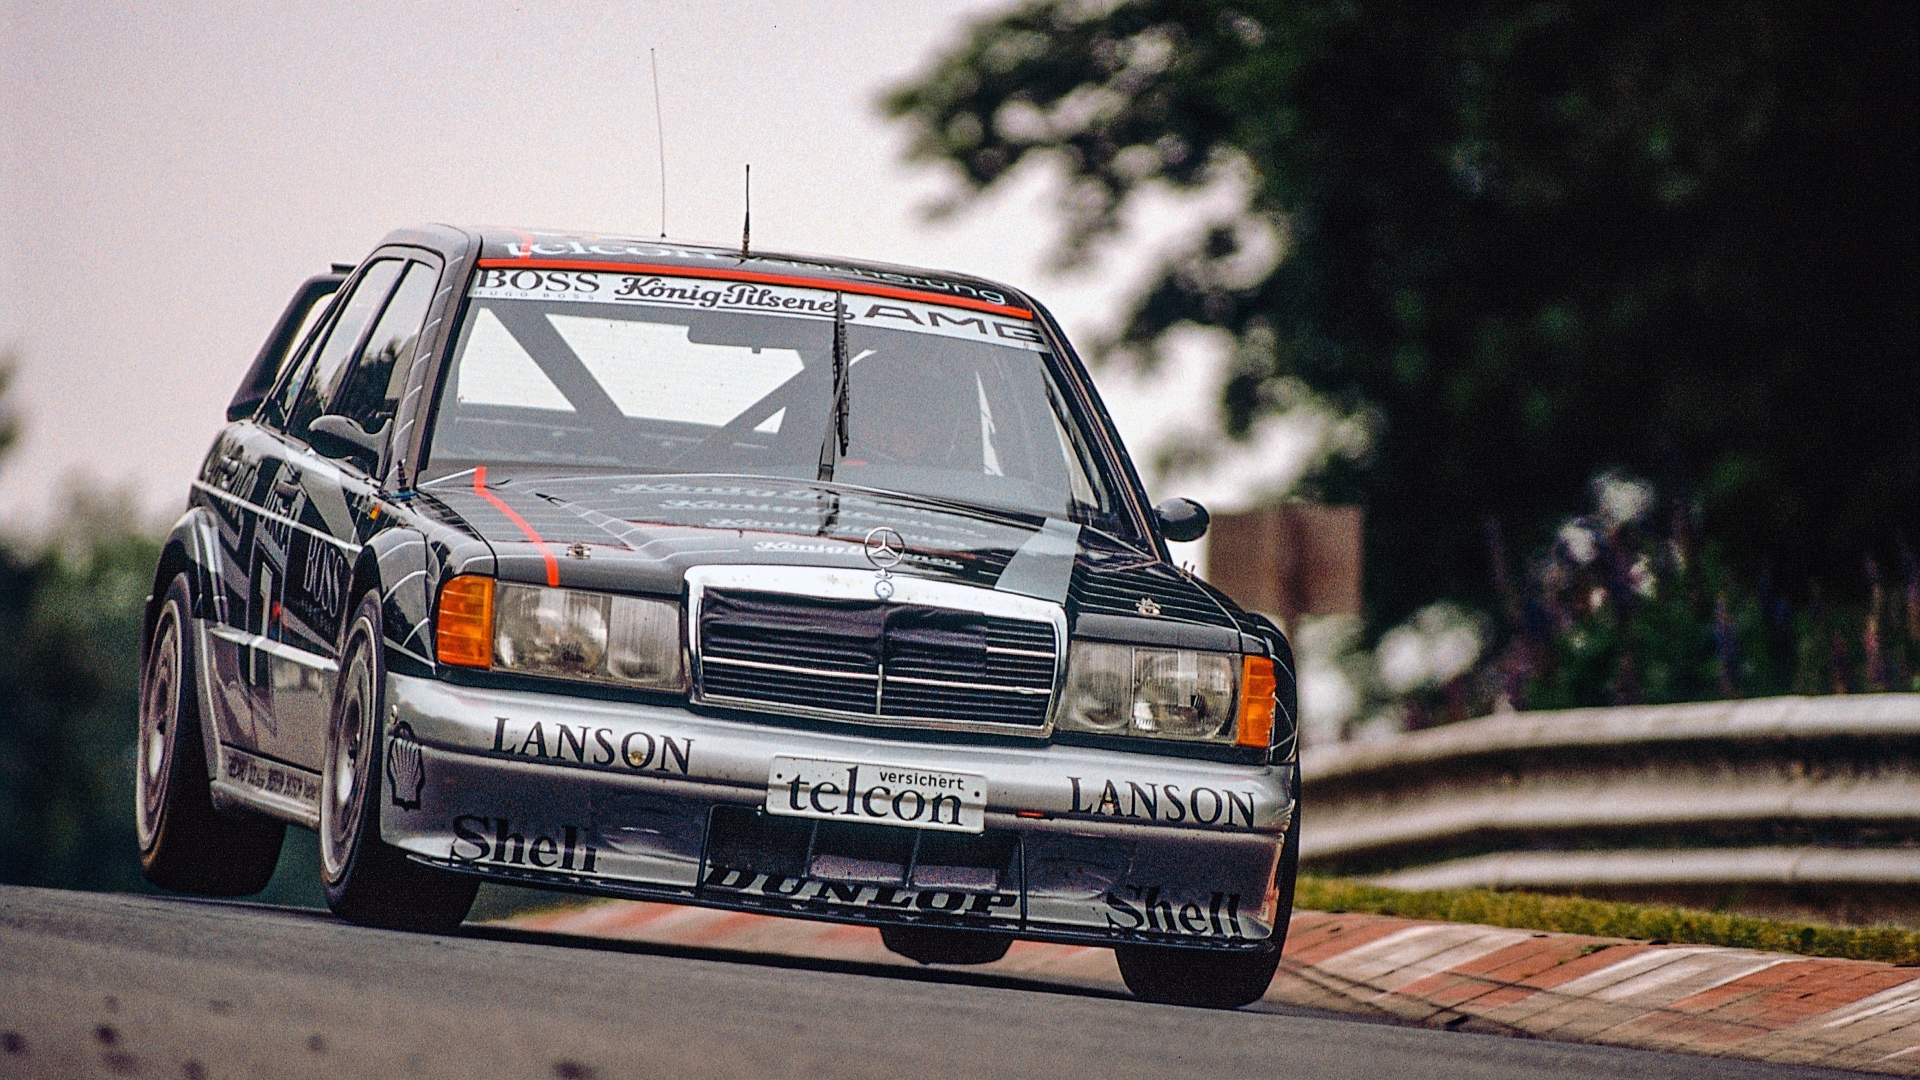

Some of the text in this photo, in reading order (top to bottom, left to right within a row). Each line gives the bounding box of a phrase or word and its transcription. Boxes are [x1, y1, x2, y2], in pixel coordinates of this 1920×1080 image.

[477, 269, 600, 293] BOSS
[864, 303, 1046, 345] AMG
[303, 534, 344, 618] BOSS
[489, 716, 695, 775] LANSON
[787, 765, 963, 827] telcon
[879, 770, 965, 791] versichert
[1067, 776, 1254, 829] LANSON
[451, 813, 598, 874] Shell
[703, 863, 1020, 915] DUNLOP
[1105, 884, 1243, 936] Shell
